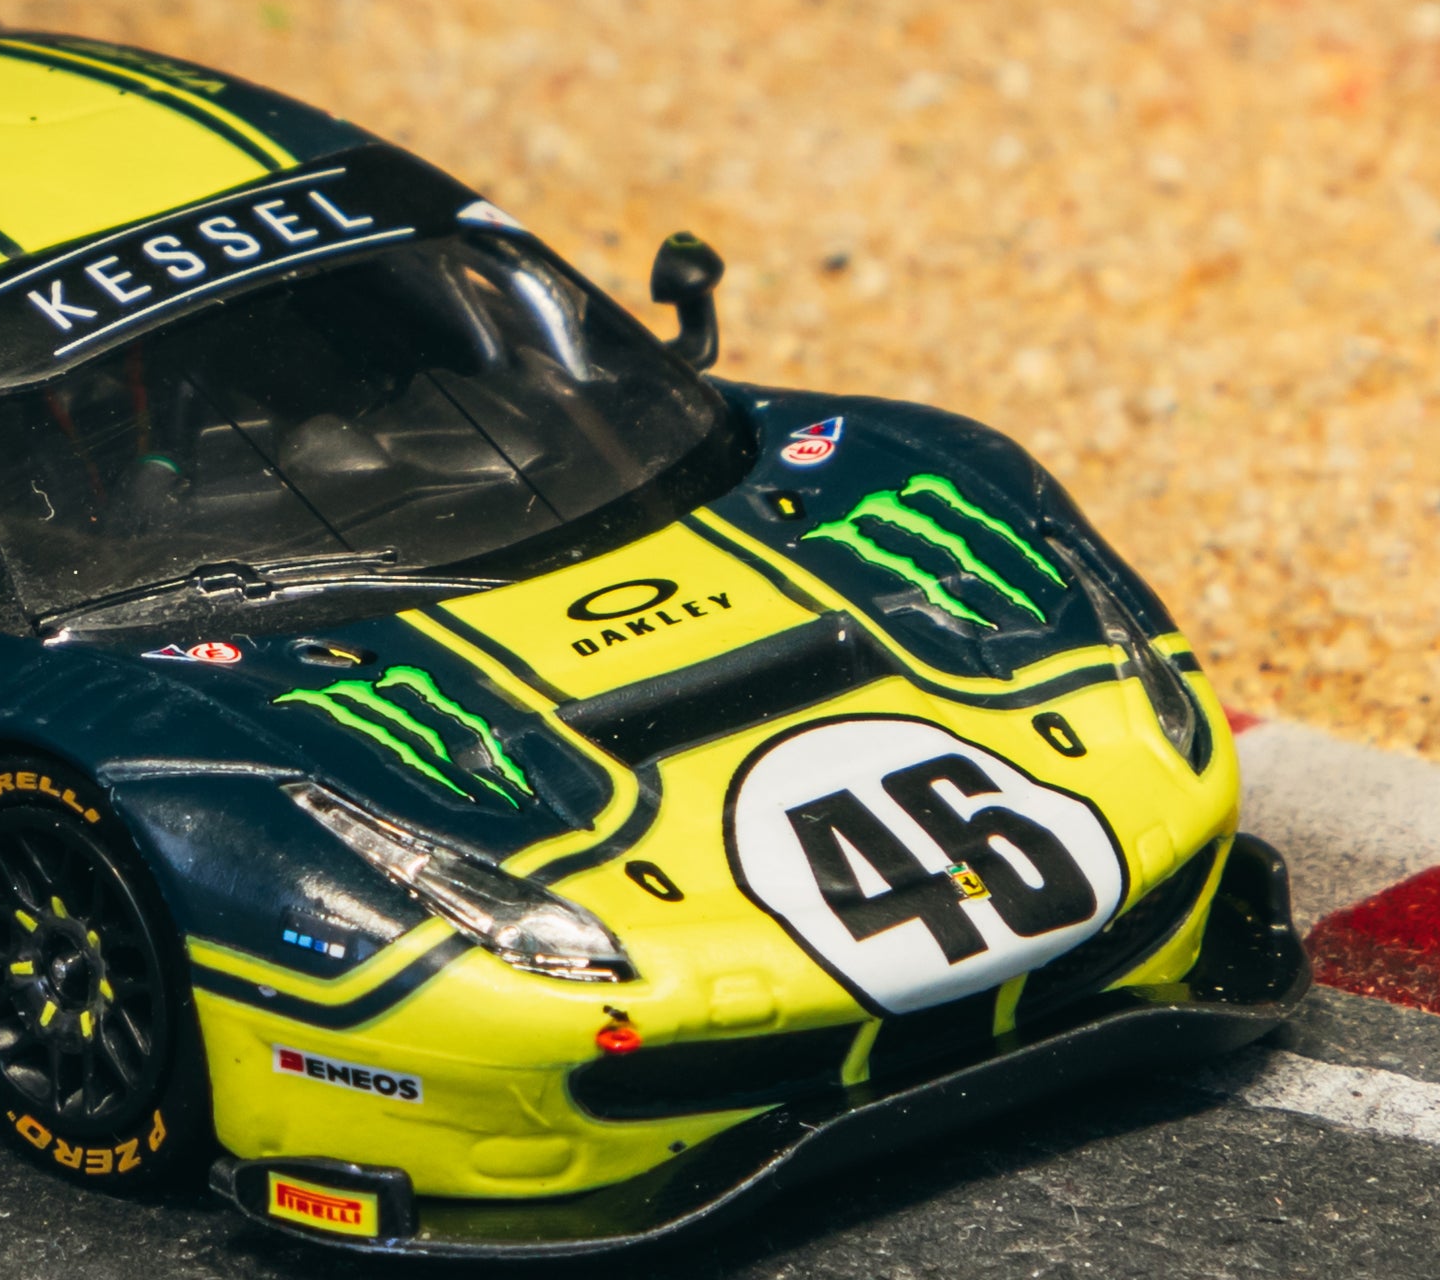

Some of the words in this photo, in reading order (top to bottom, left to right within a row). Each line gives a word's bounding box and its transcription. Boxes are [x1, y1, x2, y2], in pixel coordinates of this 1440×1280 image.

[27, 190, 374, 331] KESSEL
[570, 590, 733, 659] OAKLEY
[784, 753, 1098, 966] 46
[306, 1057, 419, 1101] ENEOS
[276, 1182, 362, 1225] PIRELLI
